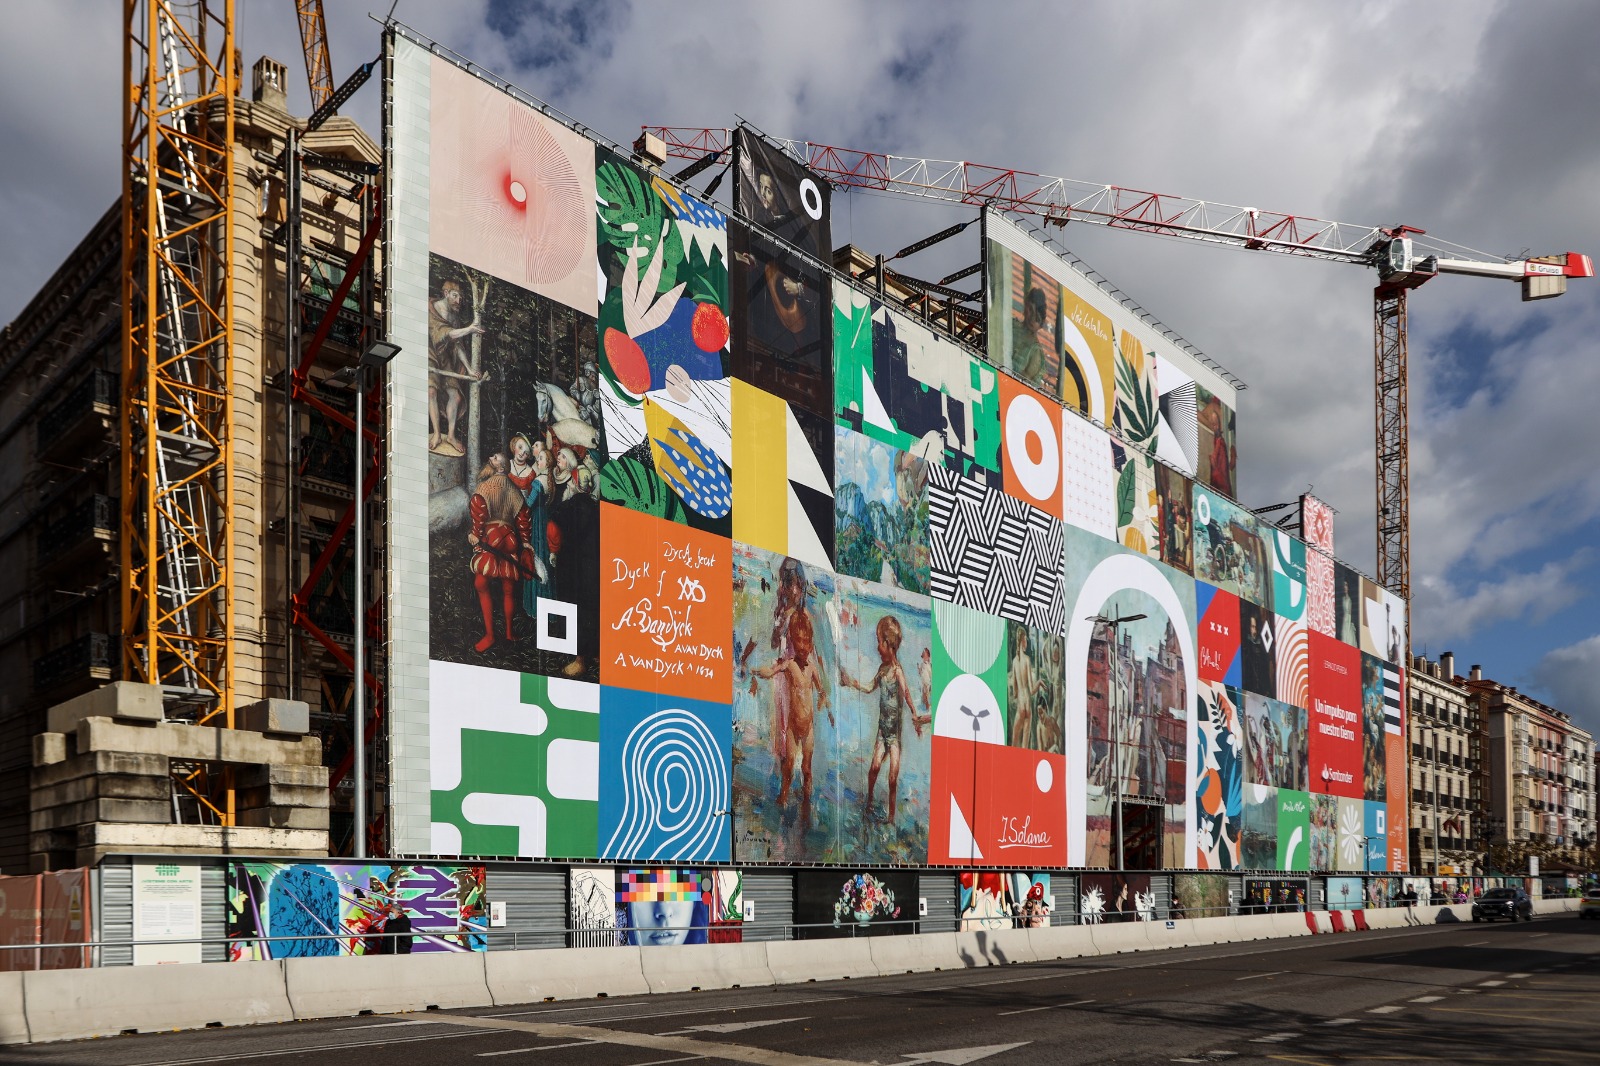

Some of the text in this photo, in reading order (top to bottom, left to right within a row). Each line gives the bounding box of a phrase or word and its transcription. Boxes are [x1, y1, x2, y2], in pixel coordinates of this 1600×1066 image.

[614, 651, 627, 668] A
[1315, 698, 1325, 714] Un
[1324, 700, 1346, 720] impulso
[1328, 767, 1354, 784] Santander
